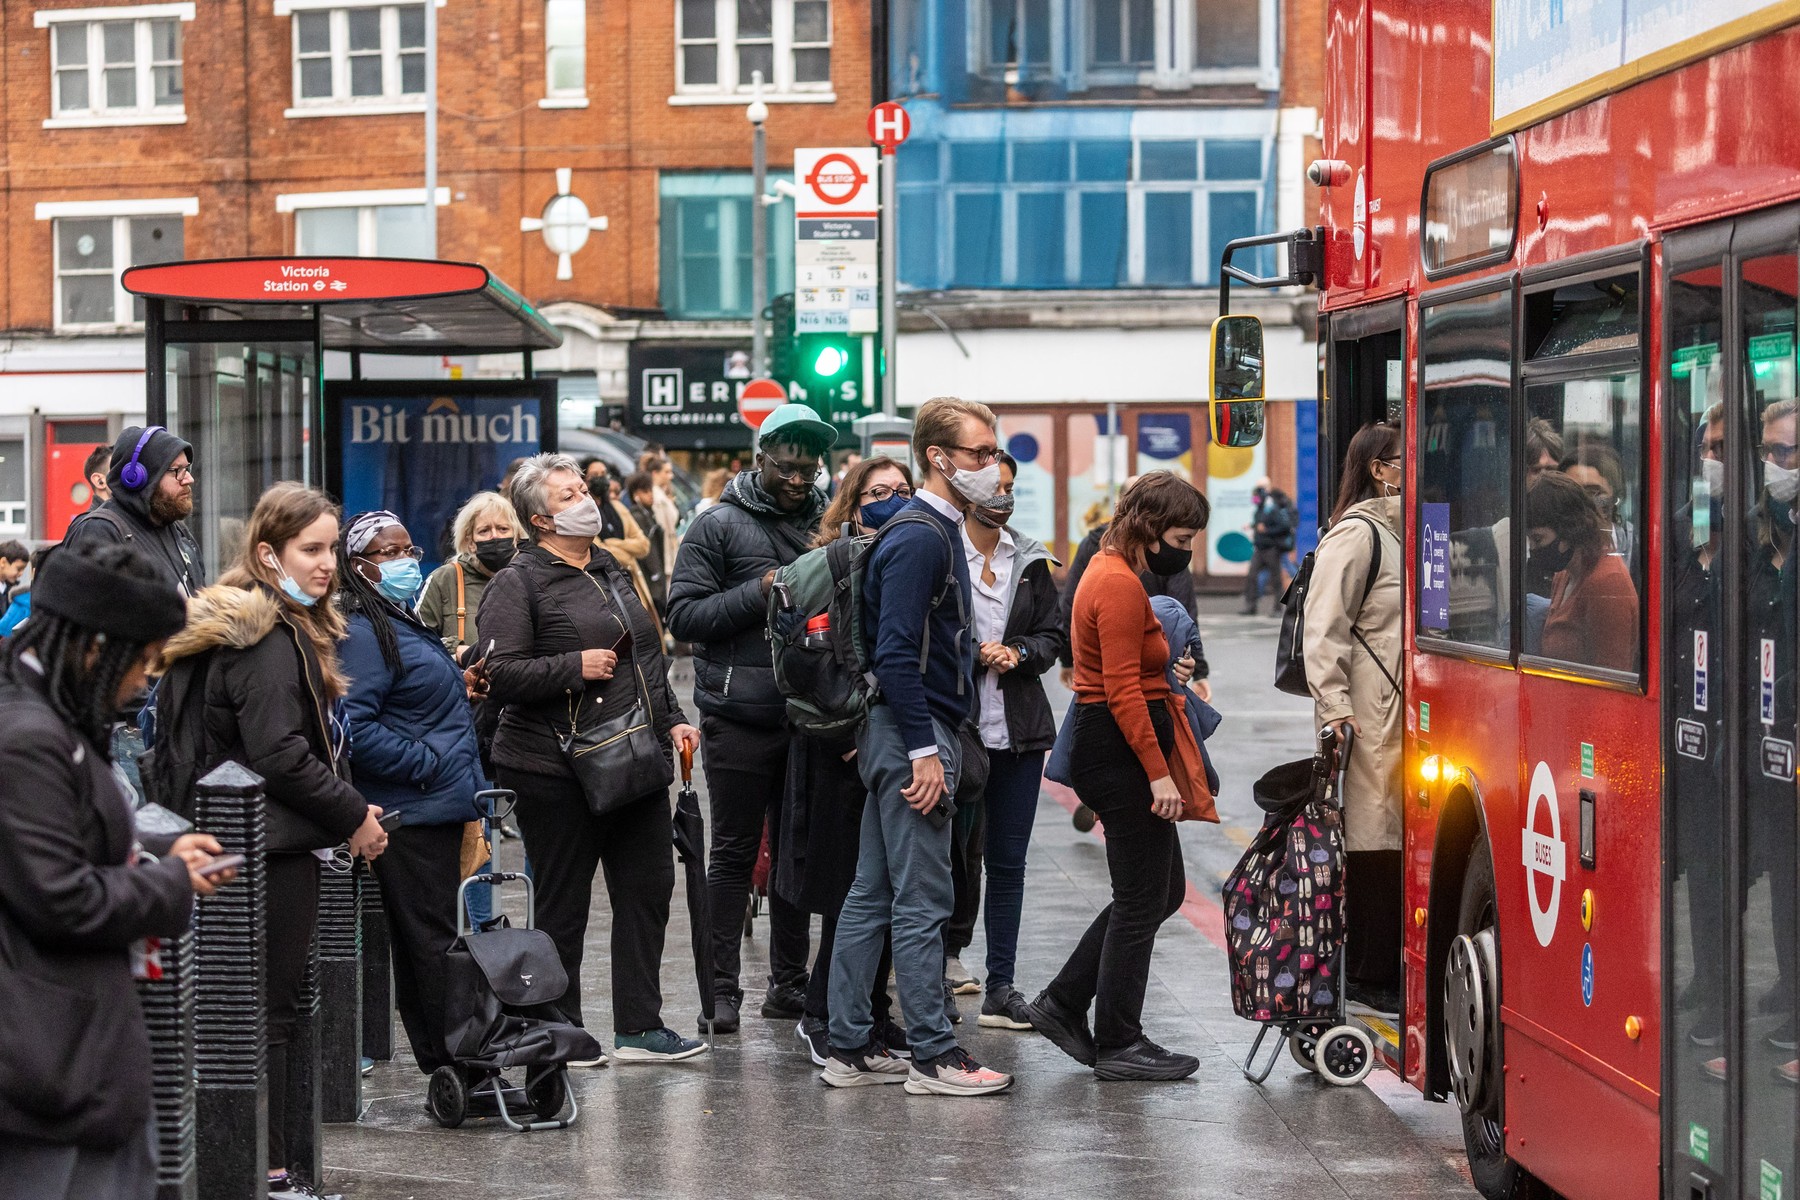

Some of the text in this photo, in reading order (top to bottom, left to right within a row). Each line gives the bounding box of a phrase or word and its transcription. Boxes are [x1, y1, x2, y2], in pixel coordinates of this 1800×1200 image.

[874, 108, 904, 141] H
[817, 174, 856, 184] BUS STOP
[822, 222, 852, 230] Victoria
[813, 230, 840, 238] Station
[281, 265, 330, 277] Victoria
[807, 272, 813, 280] 2
[263, 279, 309, 292] Station
[855, 292, 870, 301] N2
[650, 376, 858, 406] HERNS
[351, 404, 539, 444] Bit much
[642, 413, 725, 425] COLOMBIAN
[1535, 841, 1552, 867] BUSES
